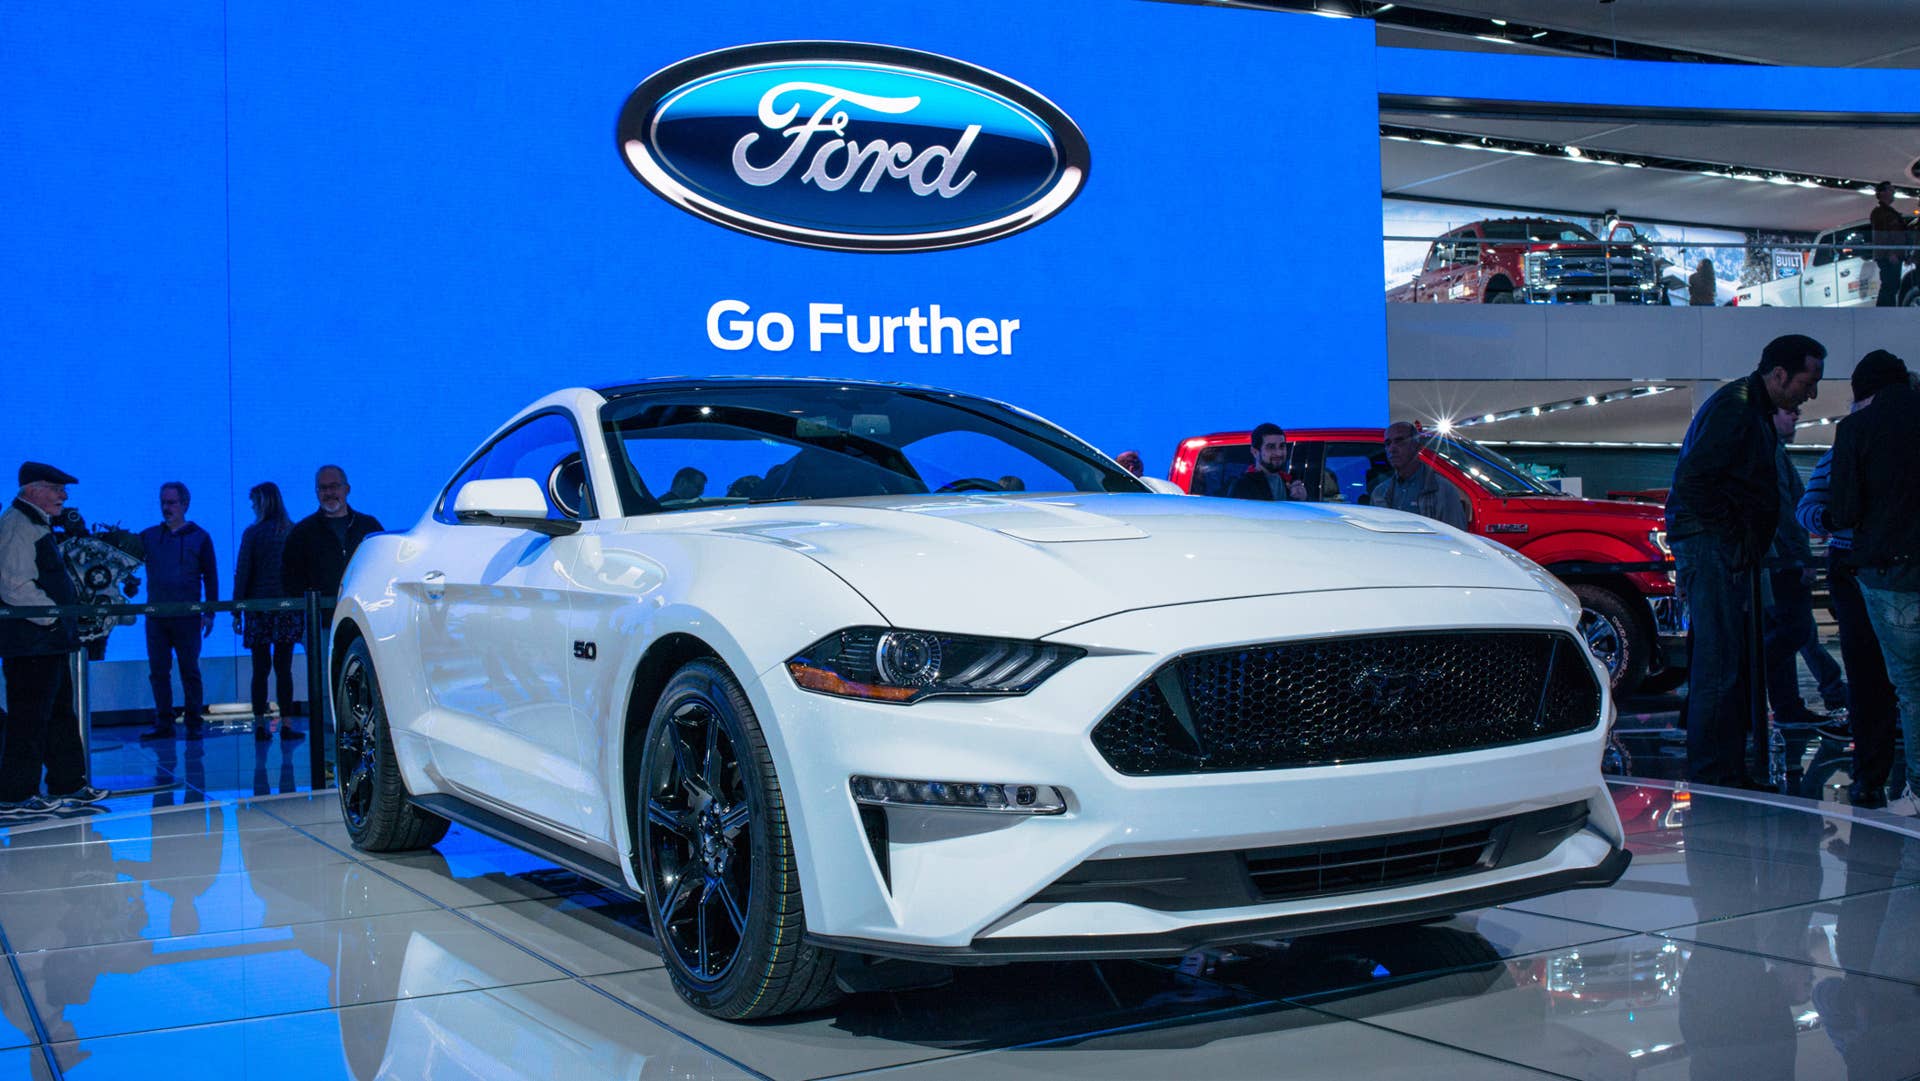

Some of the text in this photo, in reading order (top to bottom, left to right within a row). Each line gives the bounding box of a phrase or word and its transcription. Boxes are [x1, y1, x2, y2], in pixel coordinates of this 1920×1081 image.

[732, 81, 982, 199] Ford
[1776, 255, 1799, 267] BUILT
[706, 299, 1020, 355] Go Further
